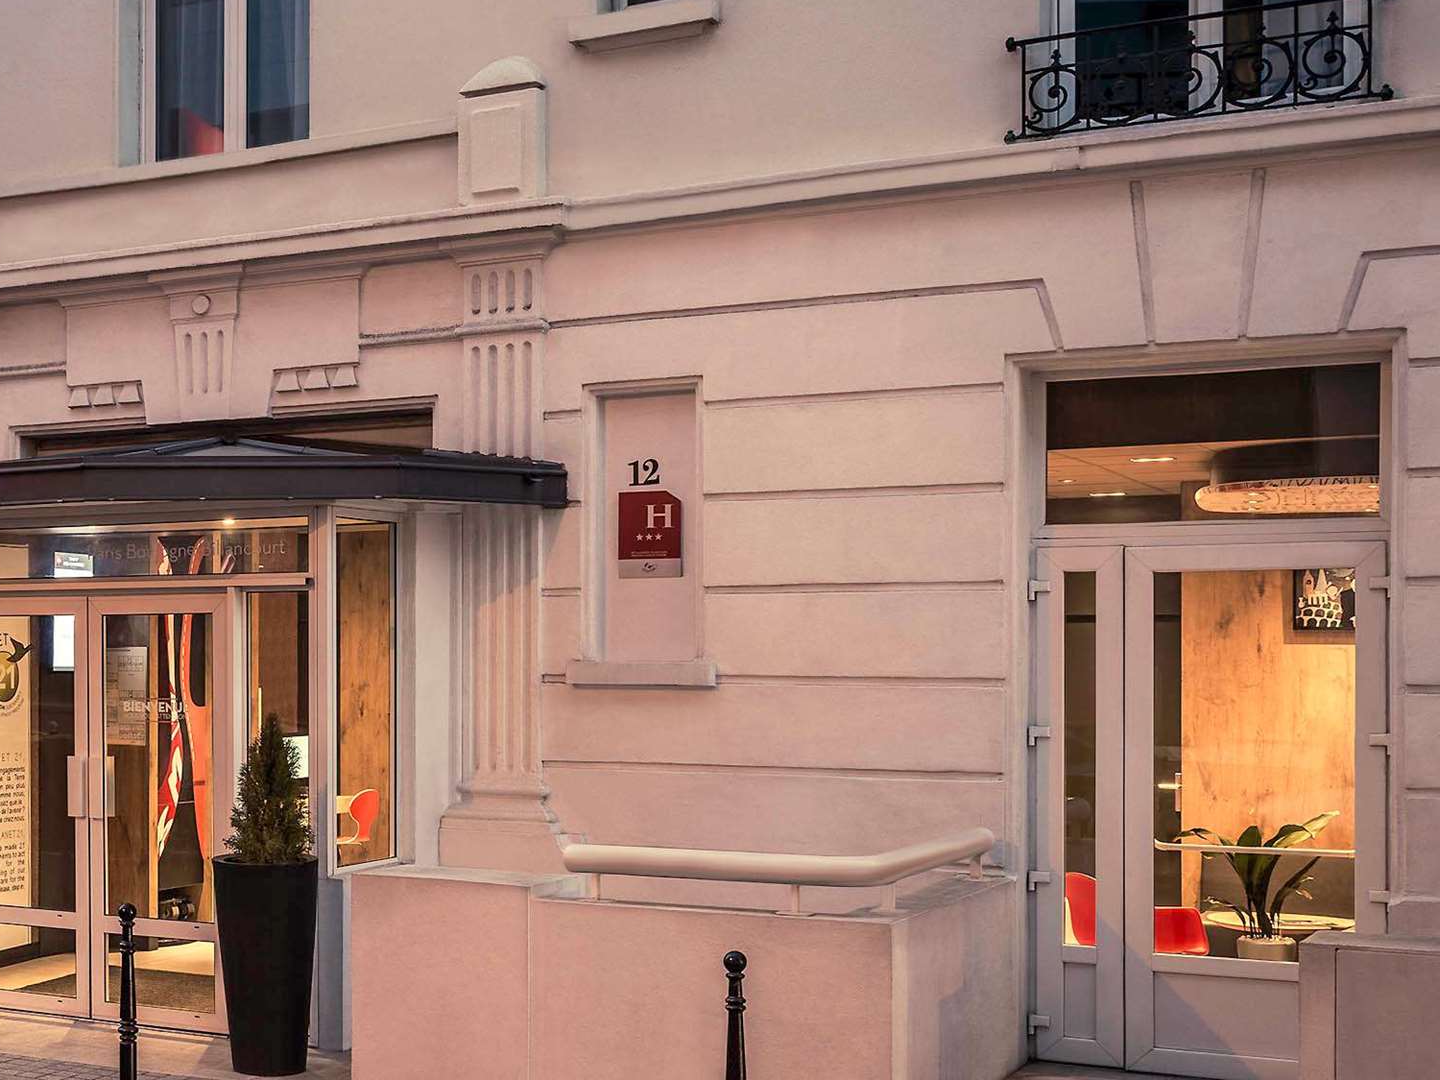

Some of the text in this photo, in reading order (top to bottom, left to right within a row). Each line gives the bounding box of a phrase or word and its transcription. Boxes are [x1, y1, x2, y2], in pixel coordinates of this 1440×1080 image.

[627, 458, 660, 486] 12
[645, 503, 674, 529] H
[126, 543, 194, 563] Bogne
[122, 700, 190, 713] BIENENU
